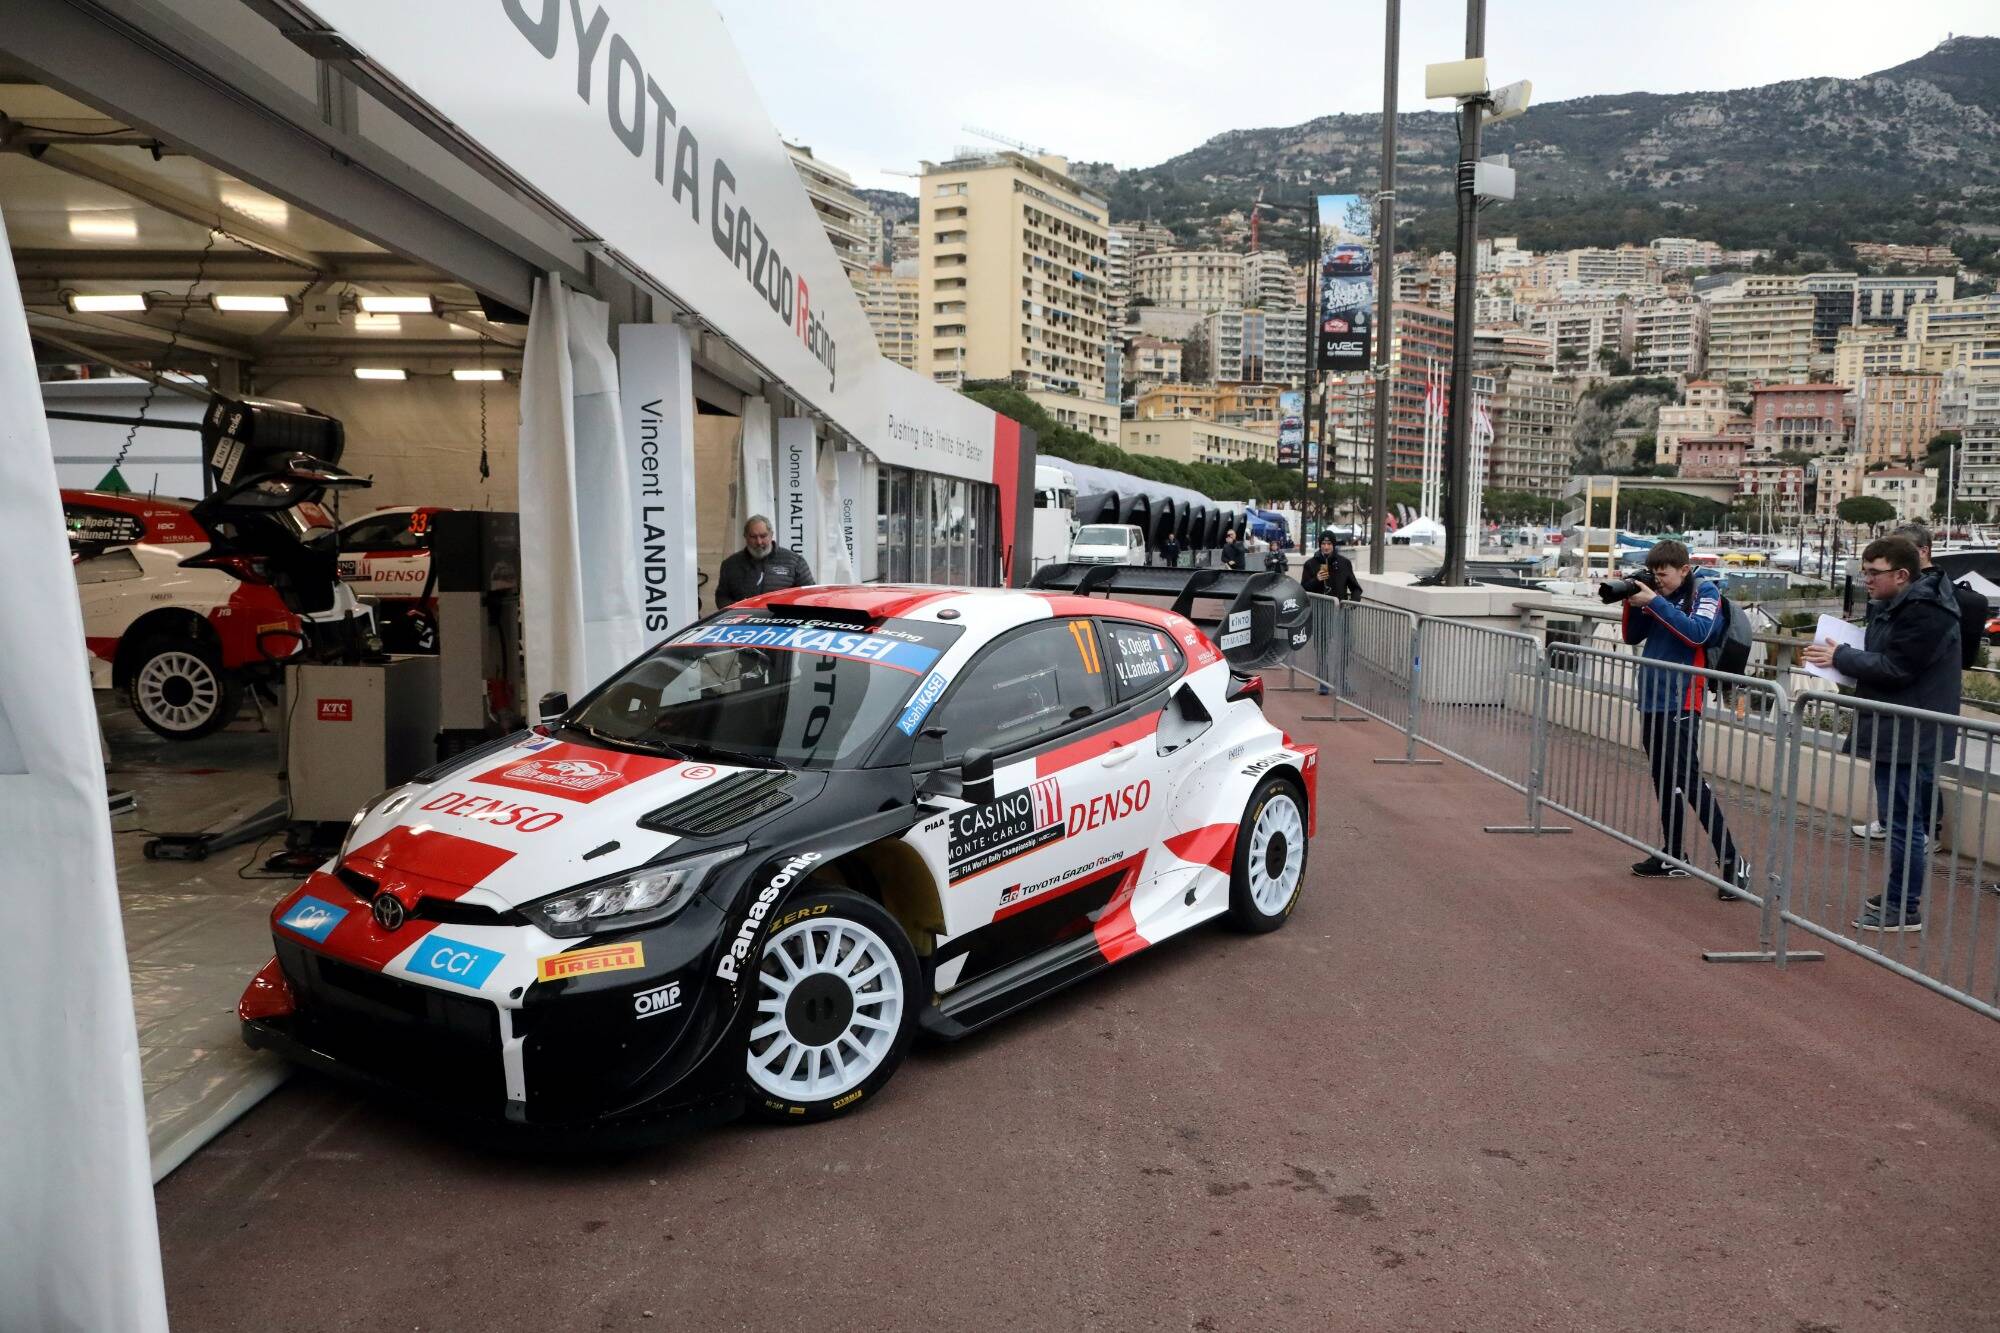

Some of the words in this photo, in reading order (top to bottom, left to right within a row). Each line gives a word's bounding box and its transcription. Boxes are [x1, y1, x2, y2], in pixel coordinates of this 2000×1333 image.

[711, 158, 793, 328] GAZOO
[796, 273, 836, 393] Racing
[1327, 341, 1363, 351] WRC
[641, 399, 663, 497] Vincent
[888, 414, 919, 450] Pushing
[922, 426, 933, 448] the
[936, 428, 953, 454] limits
[956, 438, 965, 457] for
[789, 444, 803, 488] Jonne
[408, 513, 428, 534] 33
[790, 493, 803, 554] HALTTU
[843, 498, 853, 524] Scott
[374, 570, 426, 582] DENSO
[642, 506, 669, 632] LANDAIS
[697, 624, 900, 660] AsahiKASEI
[746, 617, 800, 626] TOYOTA
[805, 619, 864, 631] GAZOO
[863, 626, 924, 642] Racing
[1069, 620, 1100, 673] 17
[1118, 637, 1152, 657] S.Ogier
[1116, 659, 1160, 680] V.Landais
[322, 703, 347, 713] KTC
[902, 674, 945, 733] AsahiKASEI
[419, 792, 564, 833] DENSO
[960, 794, 1030, 836] CASINO
[1032, 777, 1062, 829] HY
[1066, 779, 1151, 839] DENSO
[924, 818, 945, 832] PIAA
[962, 862, 972, 875] FIA
[972, 853, 988, 870] World
[988, 852, 1002, 865] Rally
[1002, 838, 1036, 858] Championship
[1023, 876, 1061, 896] TOYOTA
[1062, 862, 1095, 880] GAZOO
[1096, 851, 1124, 868] Racing
[716, 852, 823, 982] Panasonic
[769, 904, 828, 933] ZERO
[545, 947, 636, 977] PIRELLI
[635, 986, 681, 1014] OMP
